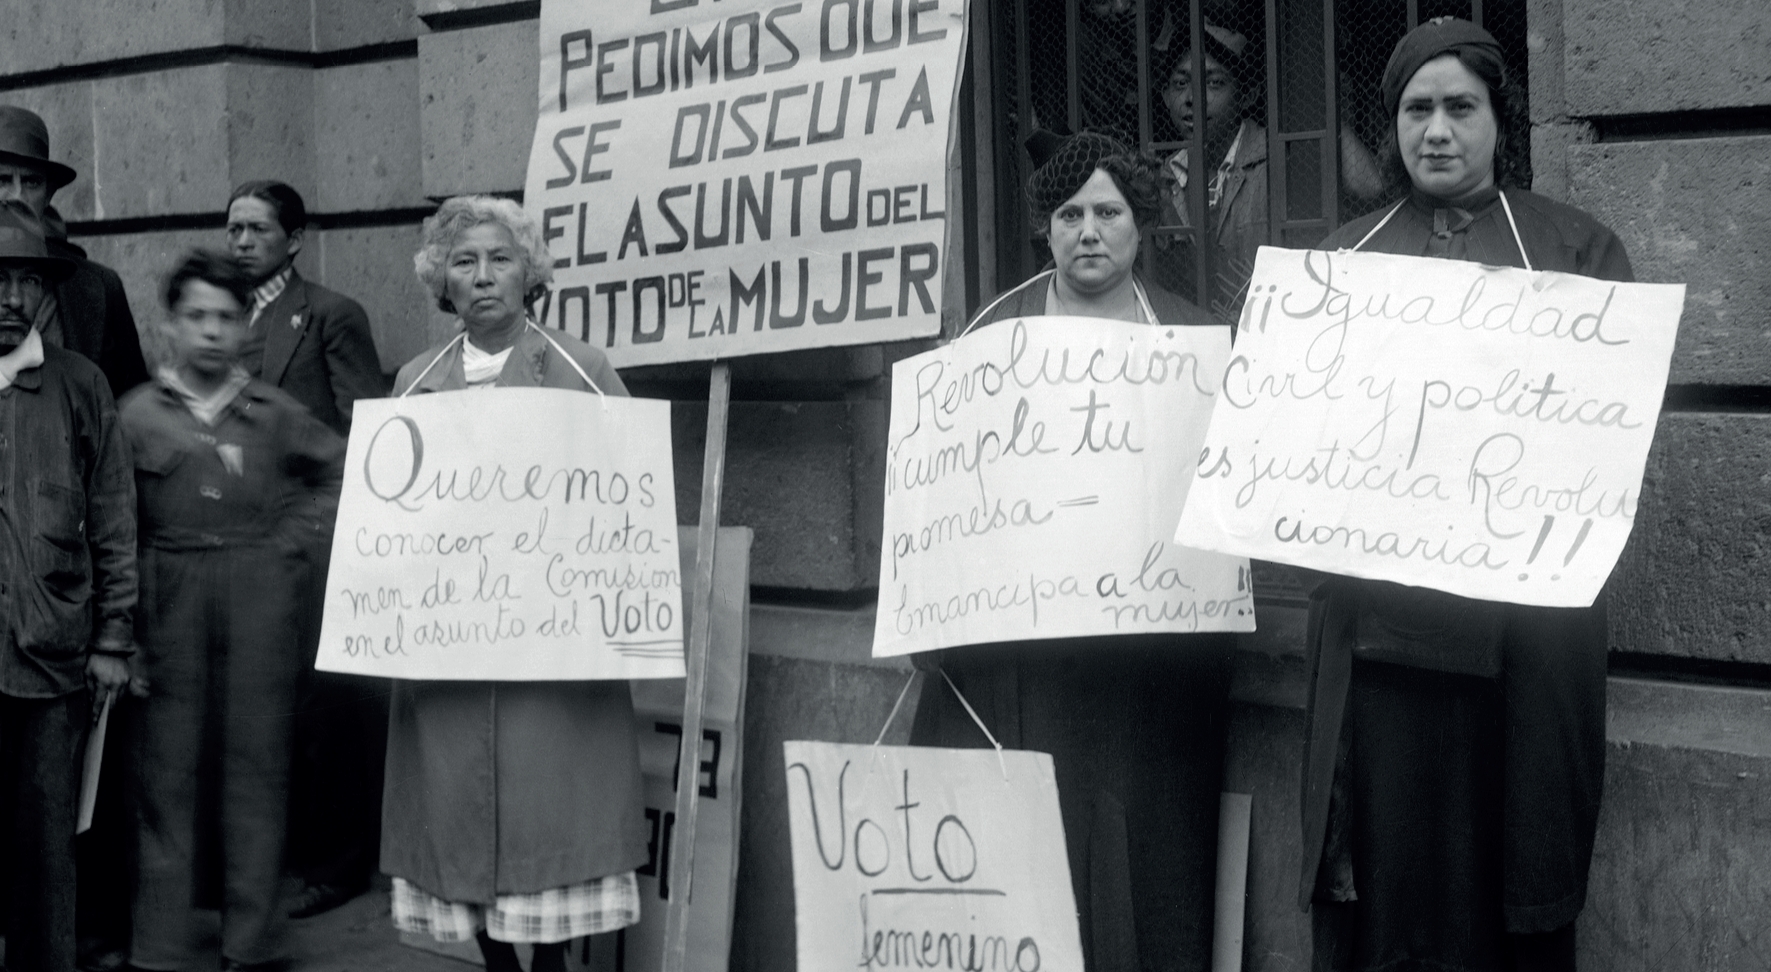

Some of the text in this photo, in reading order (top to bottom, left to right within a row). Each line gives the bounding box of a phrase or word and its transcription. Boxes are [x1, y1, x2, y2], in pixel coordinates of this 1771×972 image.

[560, 3, 801, 112] PEDIMOS
[546, 64, 935, 190] SE DISCUTA
[543, 157, 945, 270] EL ASUNTO DEL
[668, 270, 705, 309] DE
[688, 304, 726, 339] LA
[728, 242, 938, 335] MUJER
[364, 412, 655, 512] Queremos
[1071, 389, 1145, 456] tu
[1348, 375, 1400, 462] y
[1197, 446, 1231, 478] es
[1235, 440, 1450, 509] justicia
[356, 526, 494, 557] conocer
[511, 506, 550, 555] el
[1096, 573, 1128, 599] a
[1130, 540, 1190, 592] la
[341, 584, 412, 620] men
[421, 567, 461, 609] de
[473, 554, 521, 603] la
[414, 603, 526, 648] asunto
[536, 599, 582, 639] del
[590, 589, 673, 638] Voto
[788, 759, 978, 884] Voto
